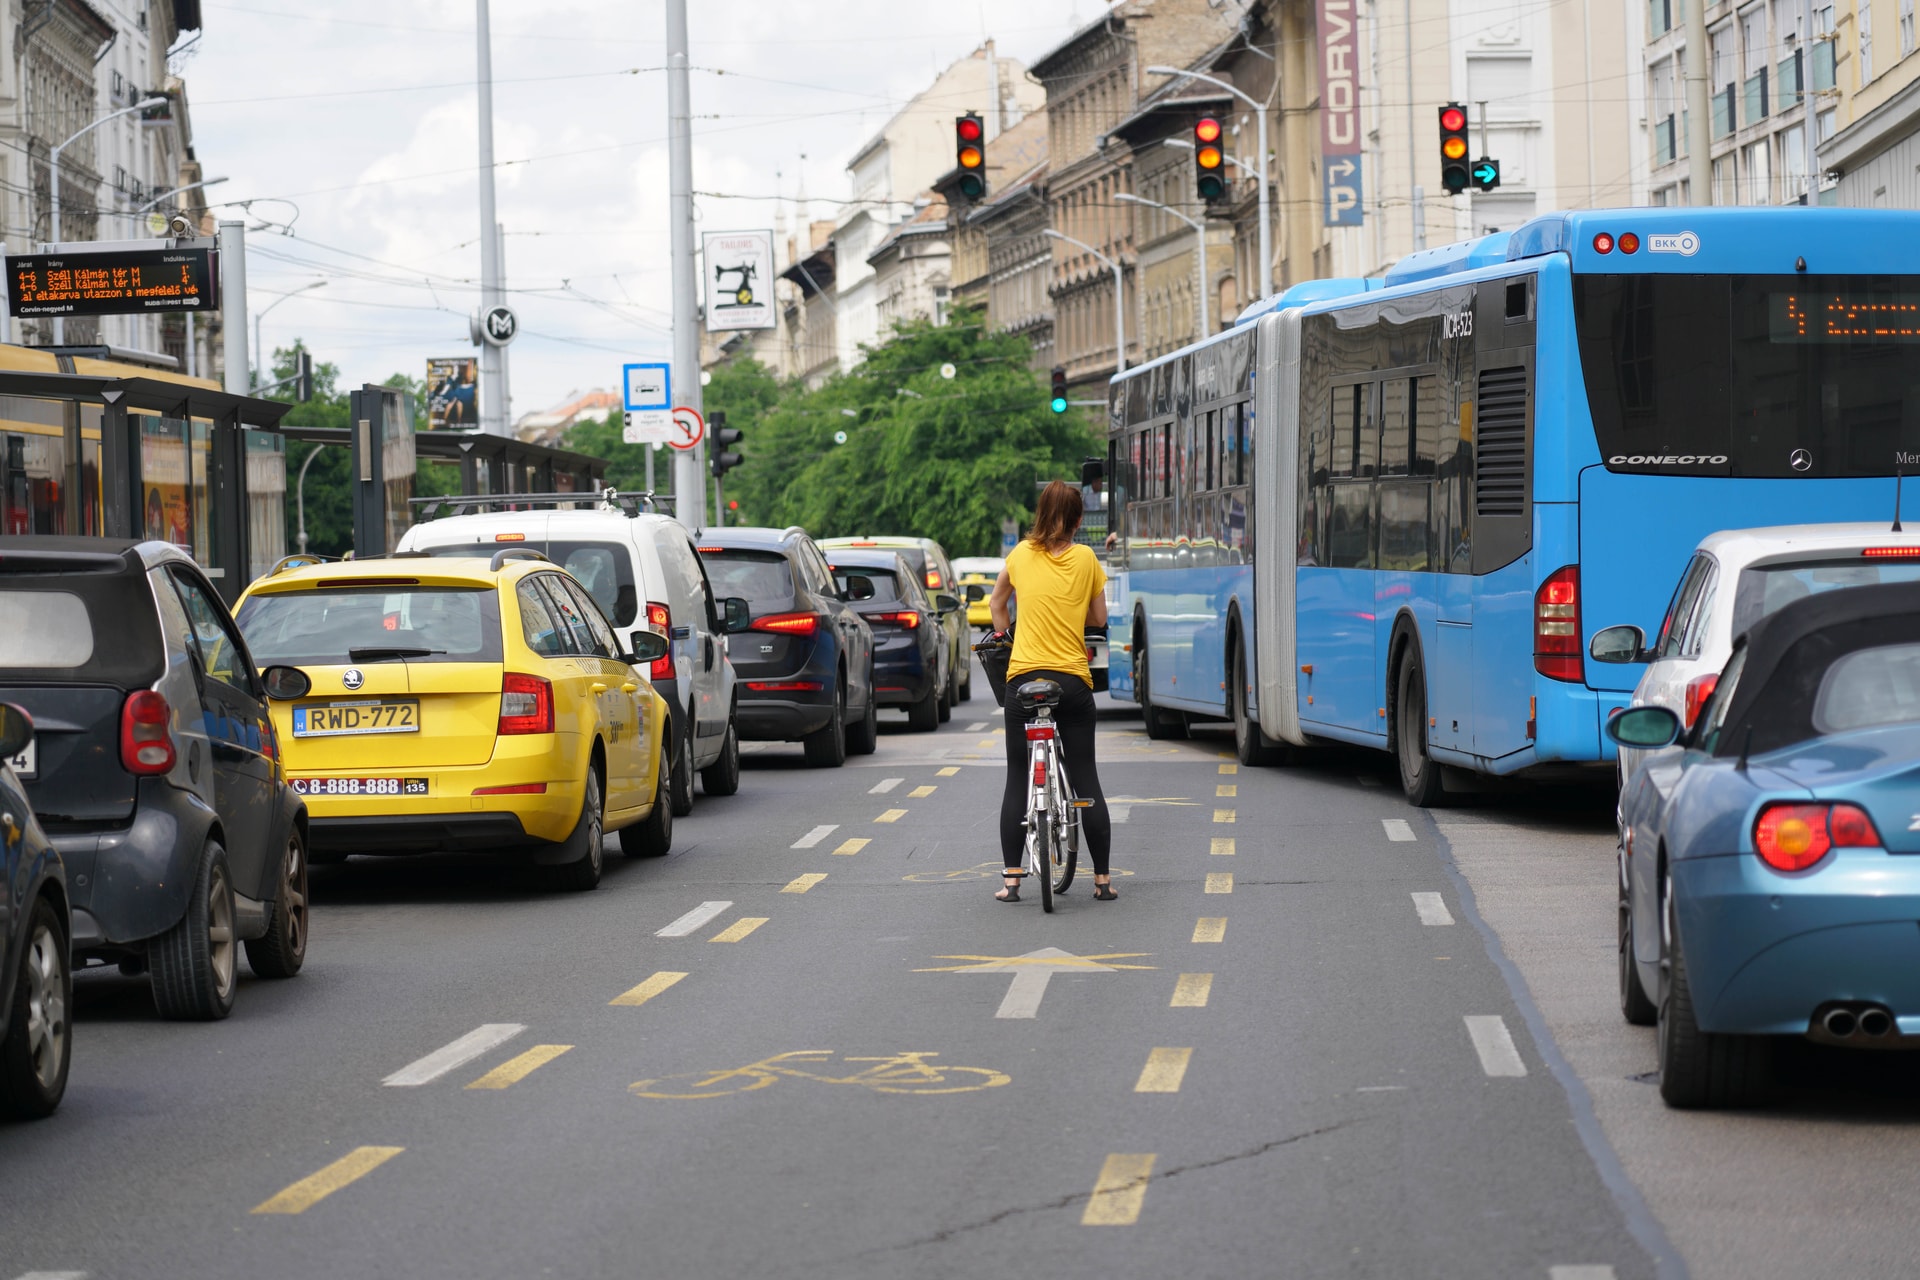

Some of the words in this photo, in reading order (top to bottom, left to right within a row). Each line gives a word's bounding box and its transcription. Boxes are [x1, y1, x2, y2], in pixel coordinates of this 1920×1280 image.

[1329, 186, 1356, 222] P
[1655, 239, 1677, 248] BKK
[19, 271, 36, 281] 4-6
[47, 269, 71, 281] Széll
[75, 269, 109, 280] Kálmán
[112, 267, 127, 278] tér
[131, 266, 140, 277] M
[19, 281, 37, 291] 4-6
[48, 280, 72, 291] Széll
[75, 279, 110, 290] Kálmán
[113, 277, 128, 288] tér
[132, 277, 141, 287] M
[36, 290, 80, 301] eltakarva
[84, 289, 122, 299] utazzon
[136, 285, 181, 297] megfelelő
[20, 304, 65, 314] Corvin-negyed
[491, 312, 513, 336] M
[1443, 311, 1473, 339] NCA-523
[1609, 455, 1728, 464] CONECTO
[1896, 451, 1920, 464] Mer
[311, 705, 412, 730] RWD-772
[297, 722, 304, 730] H
[310, 778, 399, 794] 8-888-888
[406, 783, 426, 793] 135
